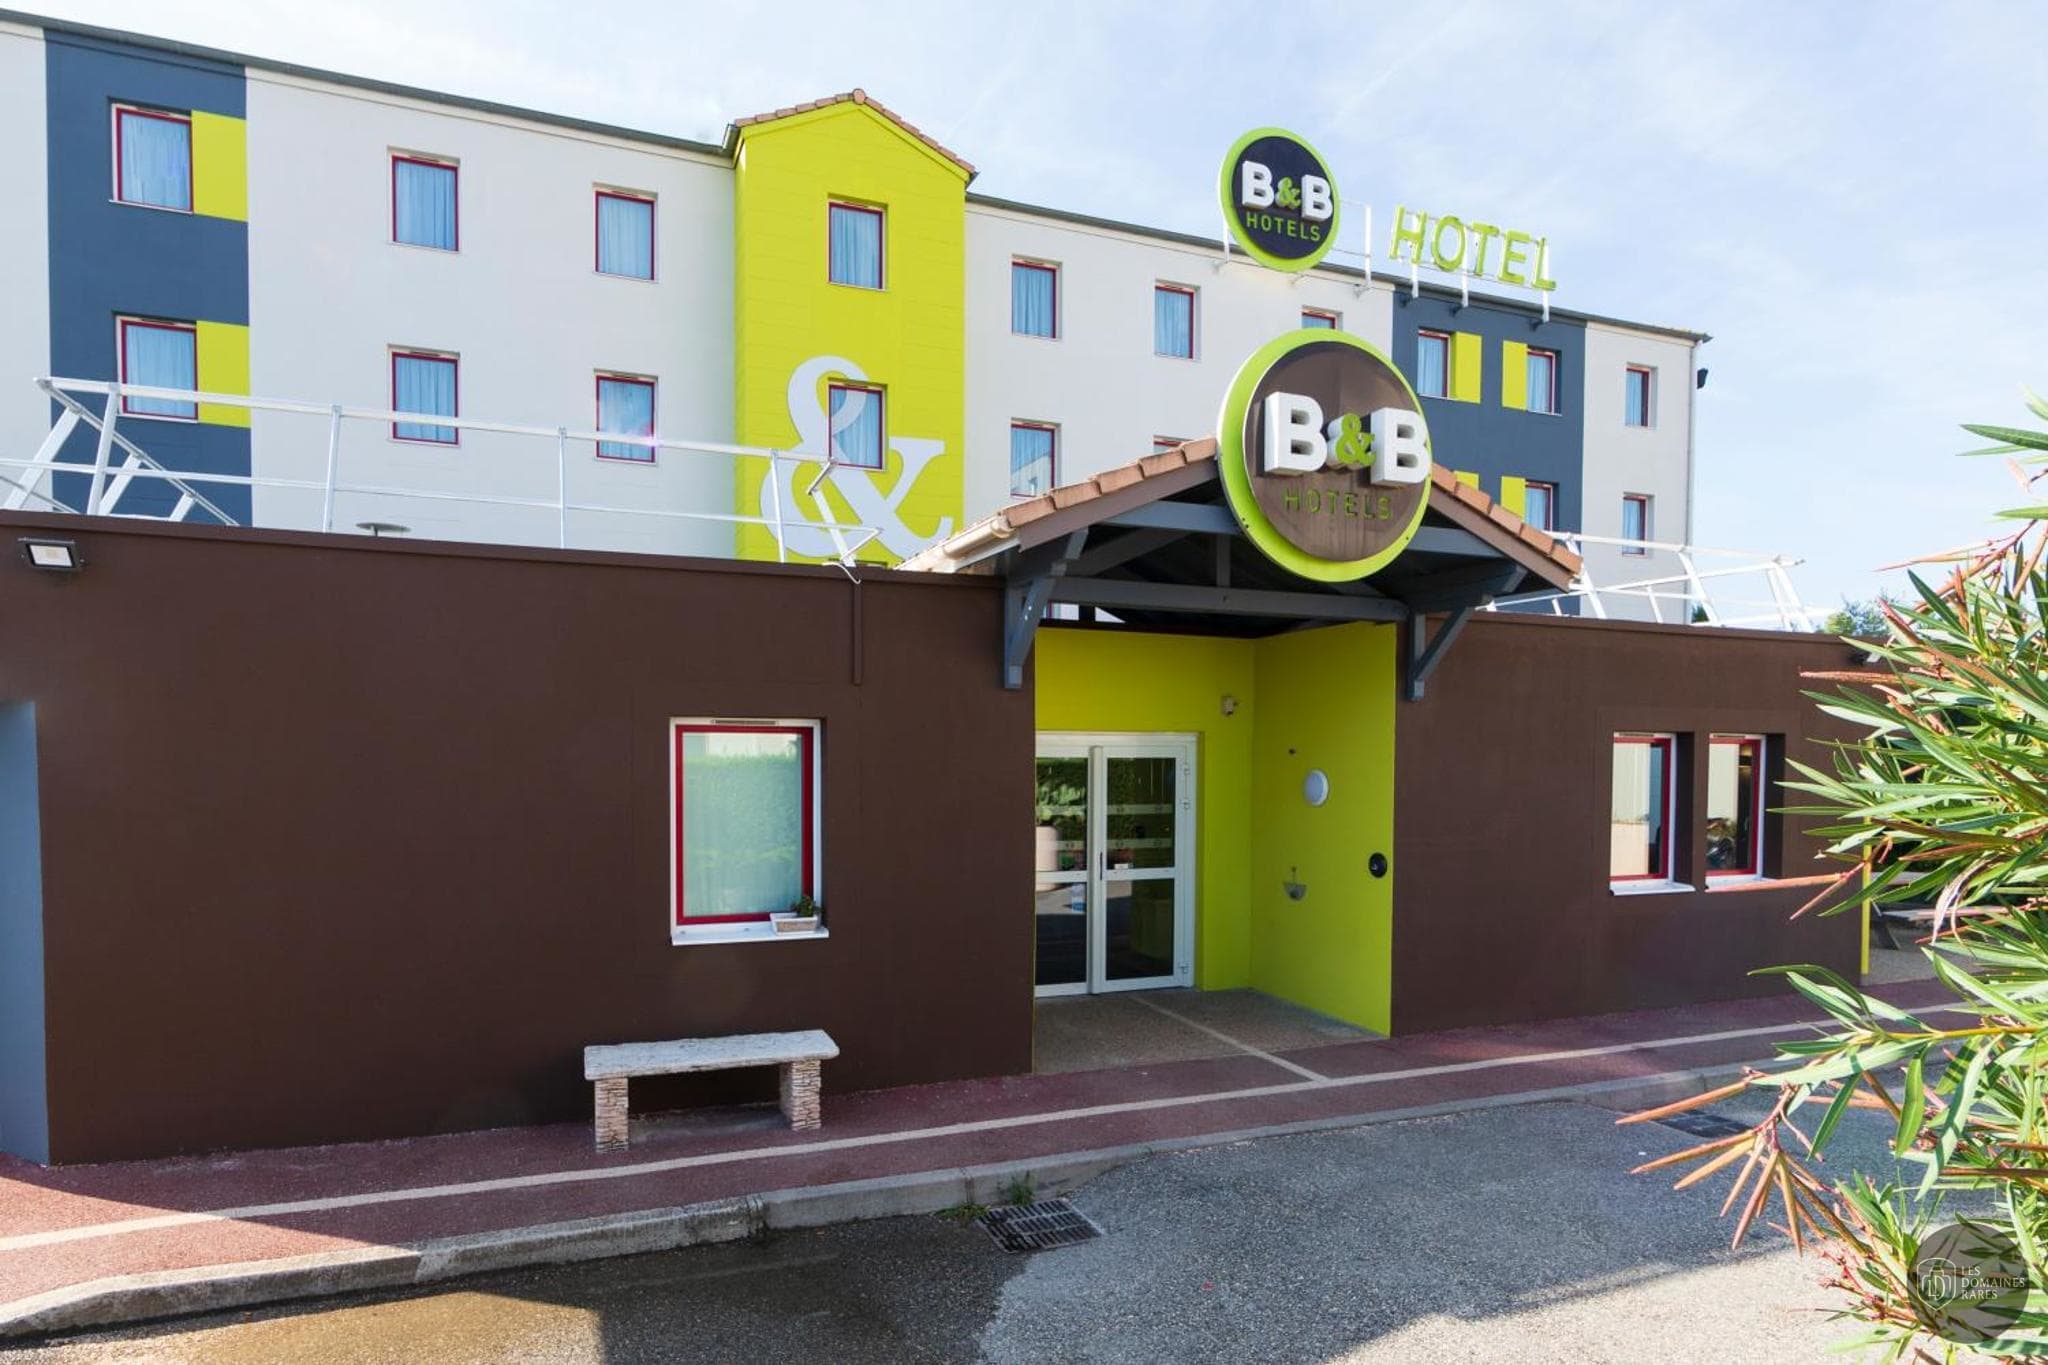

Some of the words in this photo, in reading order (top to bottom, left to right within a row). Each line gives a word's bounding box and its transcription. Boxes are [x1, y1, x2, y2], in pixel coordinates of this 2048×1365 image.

[1241, 160, 1334, 221] B&B
[1246, 212, 1322, 242] HOTELS
[1389, 205, 1556, 291] HOTEL
[1264, 391, 1431, 487] B&B
[1282, 487, 1394, 520] HOTELS
